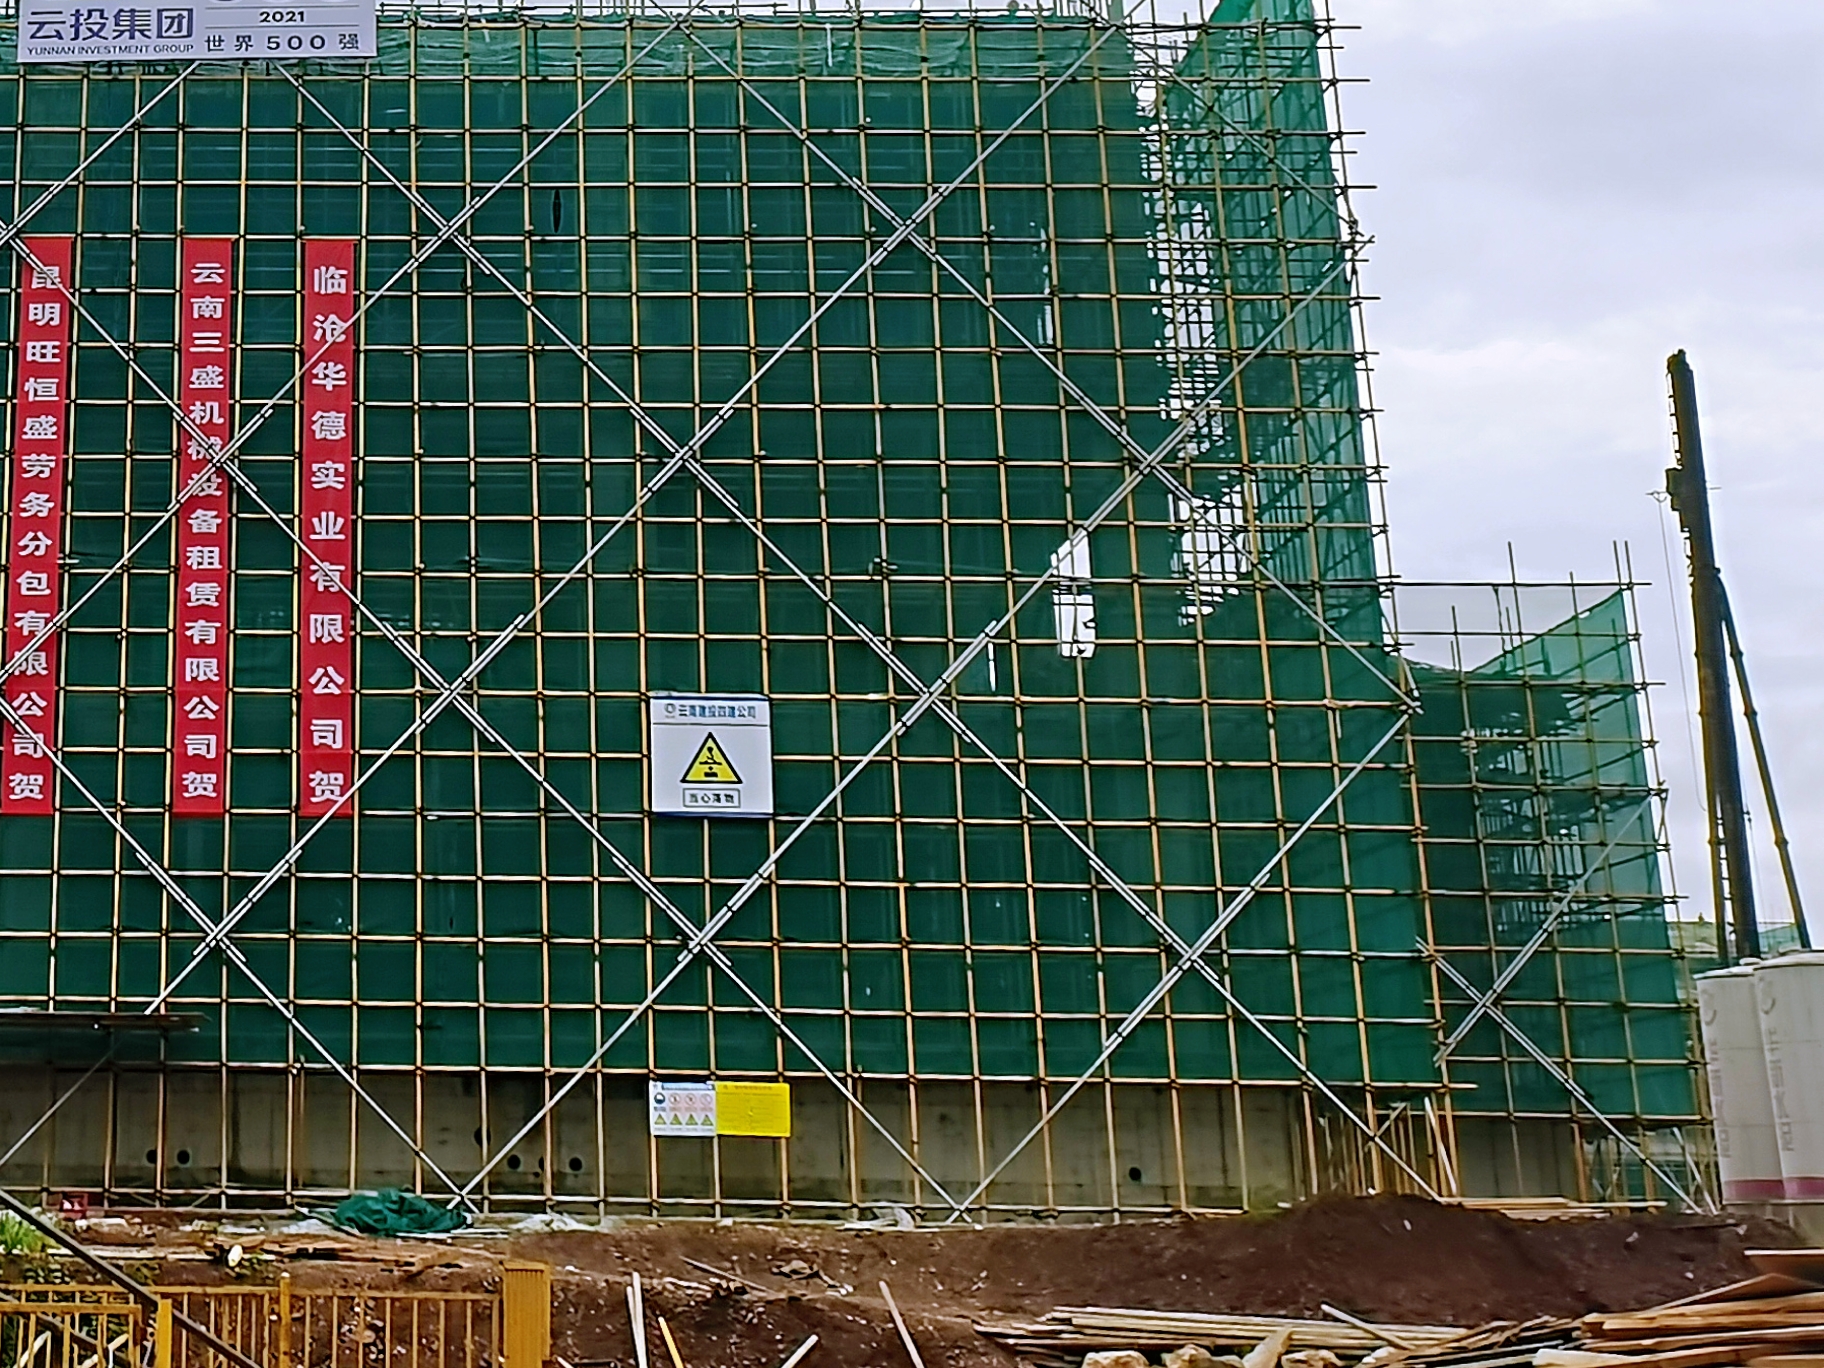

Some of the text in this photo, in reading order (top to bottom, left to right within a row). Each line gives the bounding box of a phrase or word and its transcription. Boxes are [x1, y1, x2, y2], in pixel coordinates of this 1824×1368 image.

[27, 8, 194, 41] 云投集团
[27, 44, 194, 55] YUNNAN INVESTMENT GROUP
[259, 11, 305, 23] 2021
[8, 265, 63, 800] 昆明旺恒盛劳务分包有限公司贺
[181, 263, 226, 797] 云南三盛机械设备租赁有限公司贺
[308, 266, 348, 802] 临沧华德实业有限公司贺
